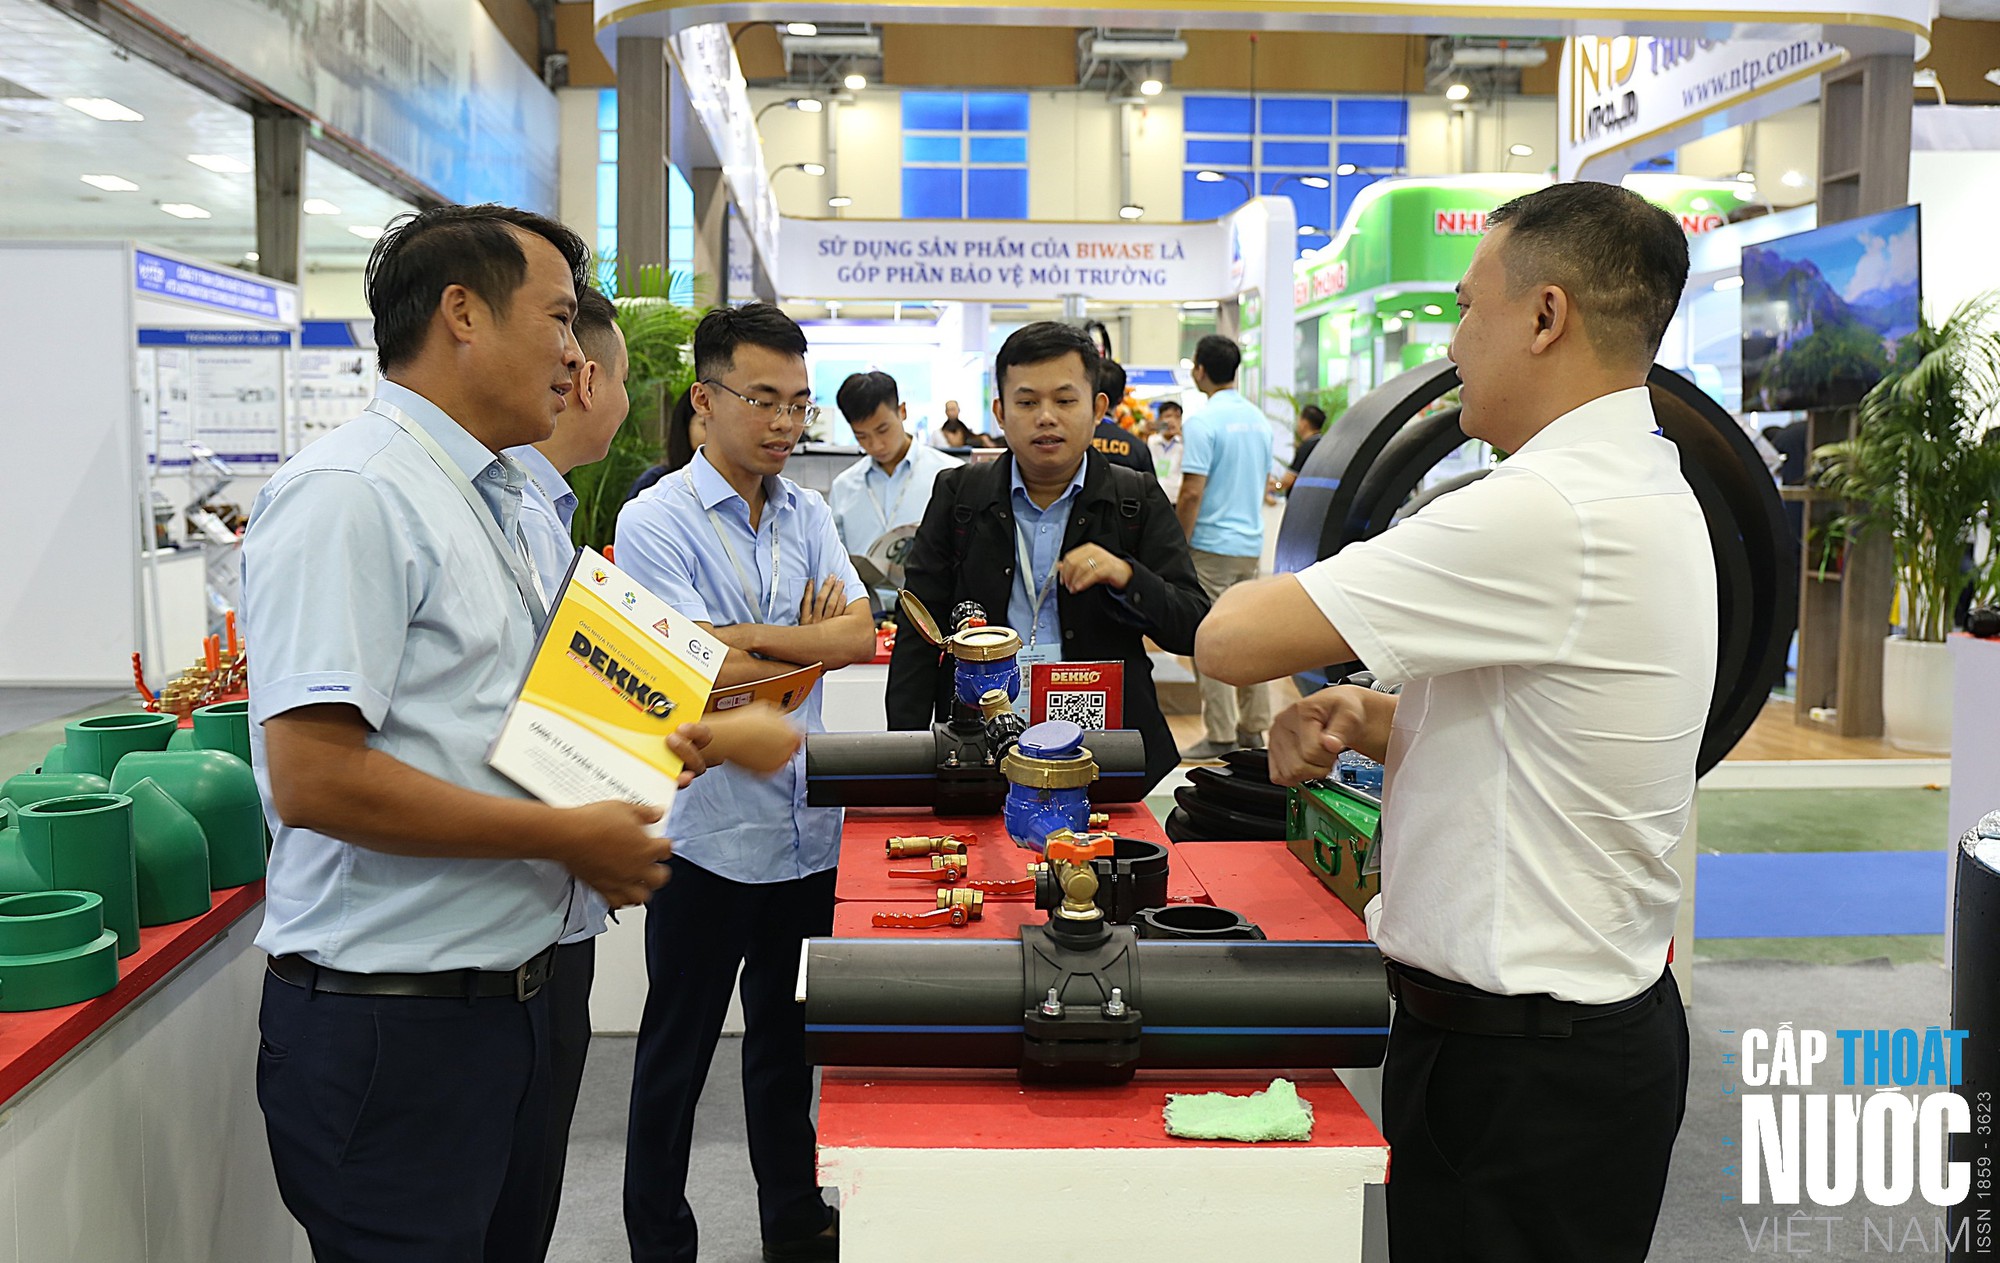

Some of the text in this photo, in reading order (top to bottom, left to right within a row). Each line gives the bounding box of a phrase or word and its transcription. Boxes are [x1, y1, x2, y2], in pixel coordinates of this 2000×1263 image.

[1682, 40, 1836, 107] www.ntp.com.v
[818, 235, 847, 256] SỬ
[853, 240, 912, 260] DỤNG
[918, 236, 958, 257] SẢN
[1031, 238, 1070, 258] CỦA
[1076, 242, 1155, 260] BIWASE
[1161, 239, 1185, 260] LÀ
[837, 260, 1167, 288] GÓP PHẦN BẢO VỆ MÔI TRƯỜNG
[569, 629, 678, 719] DEKKO
[1051, 671, 1102, 683] DEKKO
